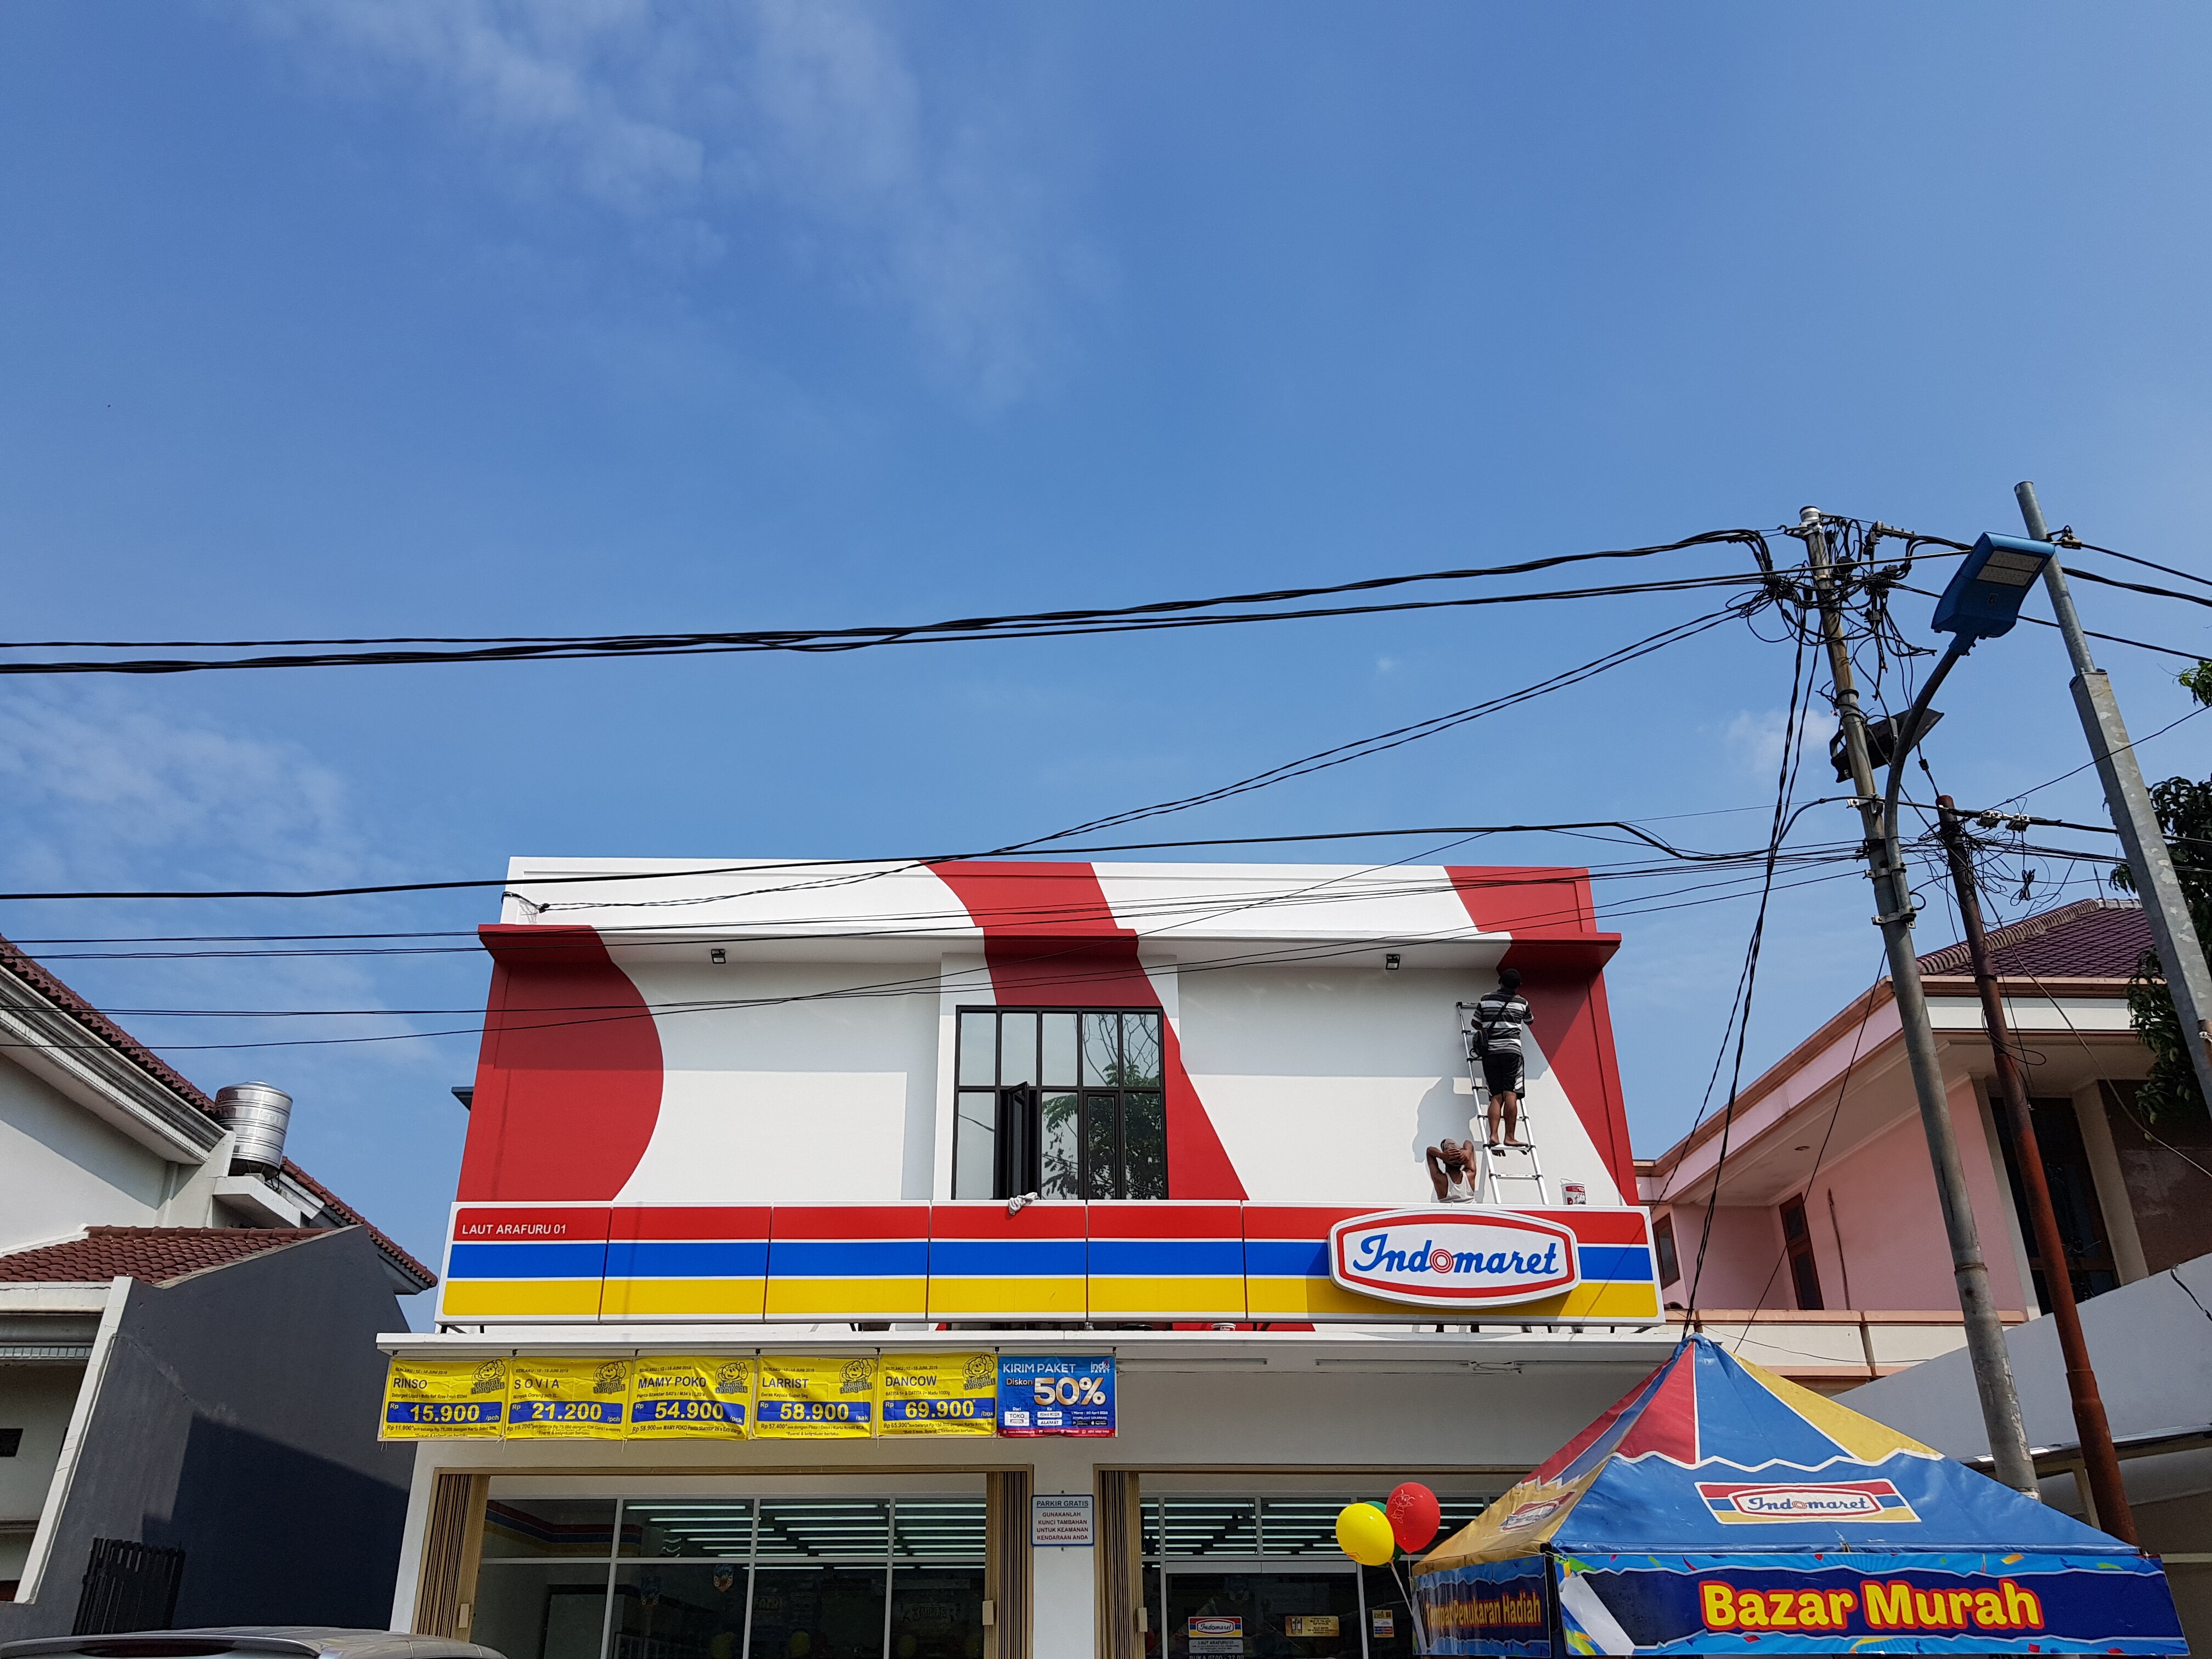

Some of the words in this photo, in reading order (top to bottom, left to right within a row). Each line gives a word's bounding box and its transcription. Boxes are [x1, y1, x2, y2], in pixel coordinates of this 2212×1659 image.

[462, 1224, 493, 1234] LAUT
[496, 1224, 551, 1234] ARAFURU
[554, 1224, 566, 1234] 01
[1353, 1233, 1559, 1274] Indomaret
[1003, 1363, 1034, 1373] KIRIM
[1037, 1363, 1076, 1373] PAKET
[393, 1378, 427, 1389] RINSO
[638, 1376, 672, 1389] MAMY
[675, 1376, 706, 1387] POKO
[762, 1378, 809, 1389] LARRIST
[885, 1376, 937, 1386] DANCOW
[1034, 1376, 1106, 1406] 50%
[410, 1404, 479, 1421] 15.900
[532, 1403, 602, 1420] 21.200
[655, 1402, 724, 1419] 54.900
[780, 1403, 849, 1420] 58.900
[1747, 1496, 1871, 1511] Indomaret
[1426, 1598, 1454, 1629] Tempat
[1454, 1597, 1502, 1626] Penukaran
[1503, 1590, 1541, 1624] Hadiah
[1701, 1583, 1854, 1628] Bazar
[1863, 1579, 2042, 1627] Murah
